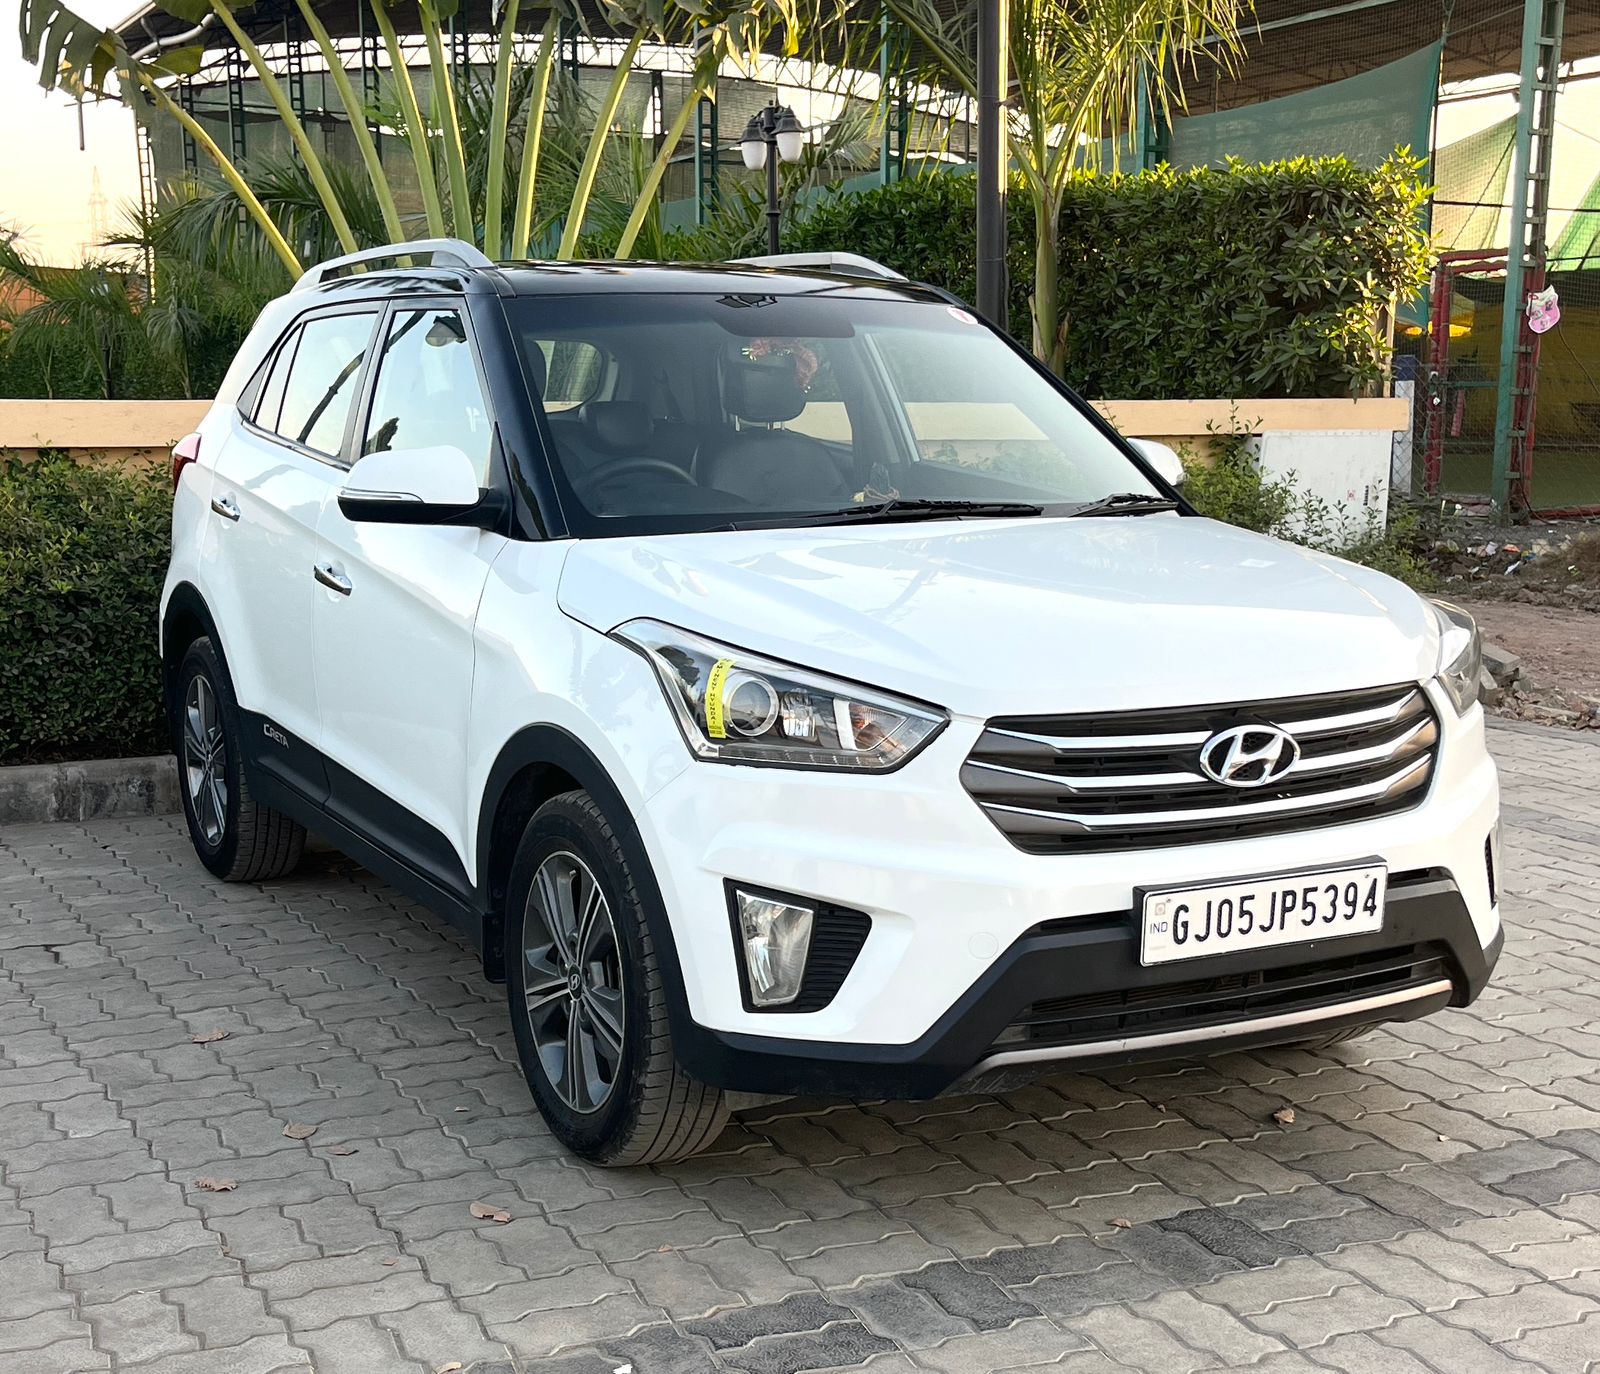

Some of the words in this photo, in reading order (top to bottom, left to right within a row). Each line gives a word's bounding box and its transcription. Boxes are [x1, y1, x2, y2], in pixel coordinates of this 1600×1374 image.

[263, 723, 289, 749] CRETA
[1172, 877, 1377, 945] GJ05JP5394
[1150, 921, 1168, 934] IND
